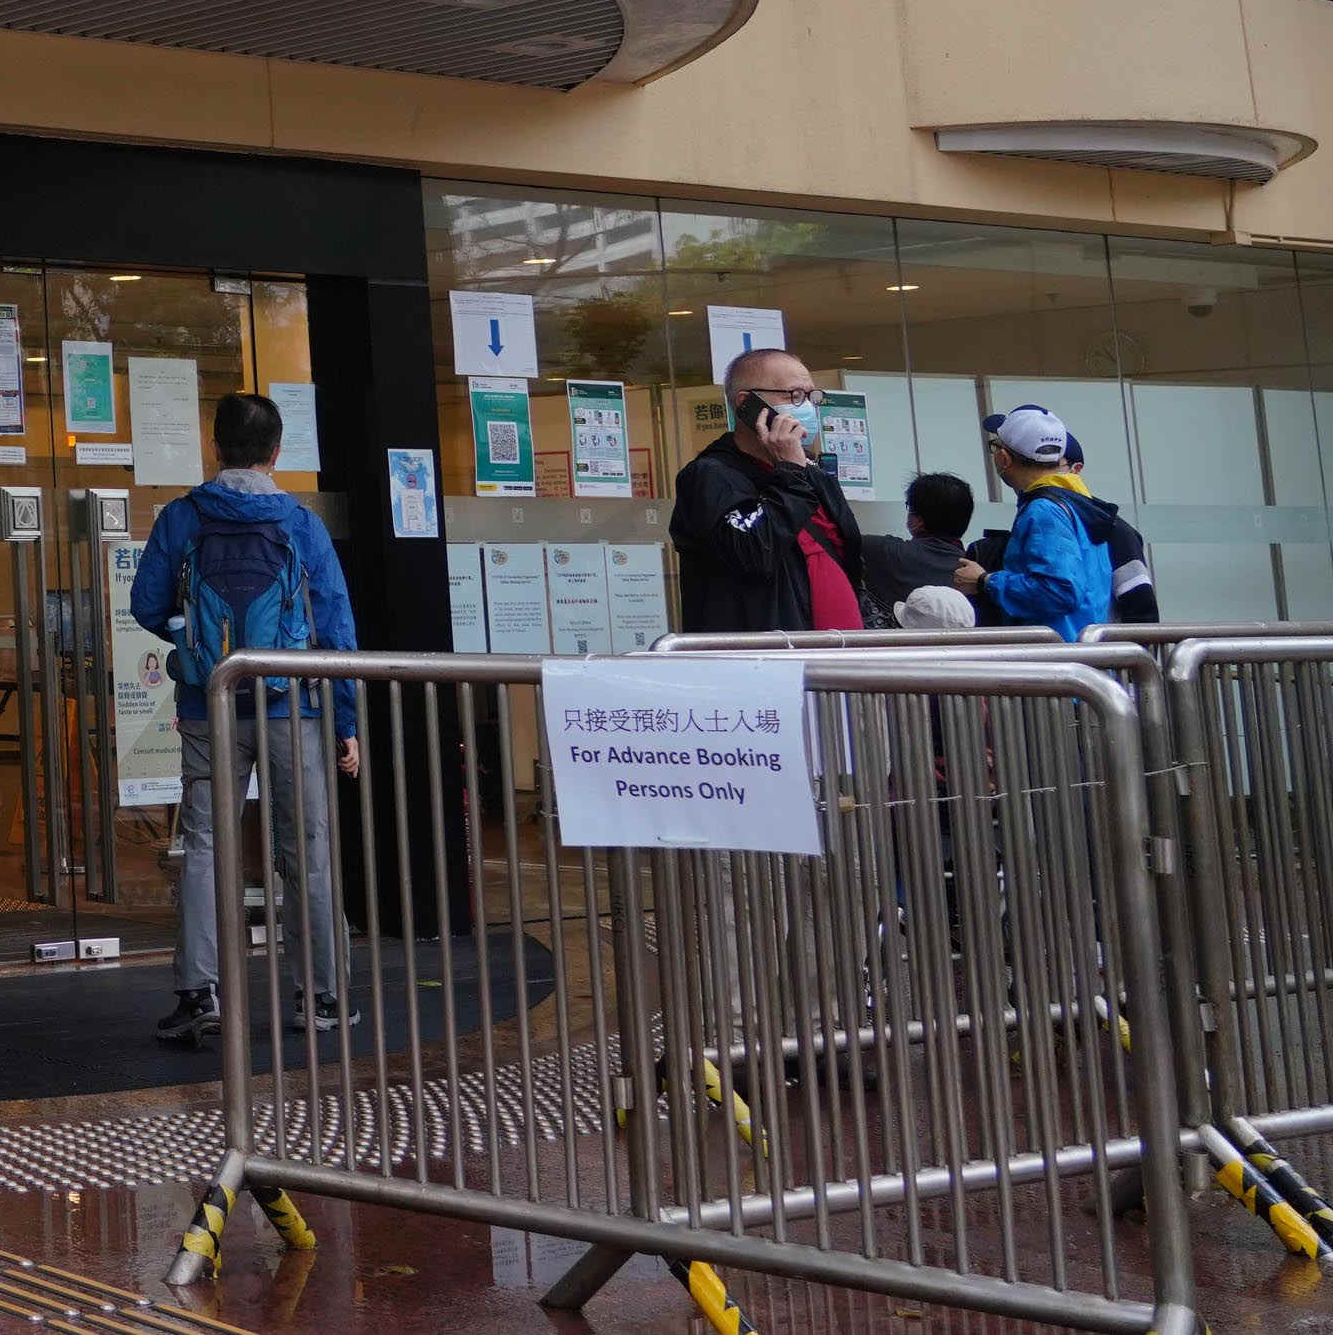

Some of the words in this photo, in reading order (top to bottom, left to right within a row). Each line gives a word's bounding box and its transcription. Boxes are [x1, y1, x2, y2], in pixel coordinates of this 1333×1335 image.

[564, 708, 781, 734] 只接受預約人士入場
[570, 746, 601, 763] For
[608, 746, 691, 766] Advance
[697, 748, 782, 772] Booking
[615, 780, 694, 799] Persons
[699, 782, 745, 805] Only
